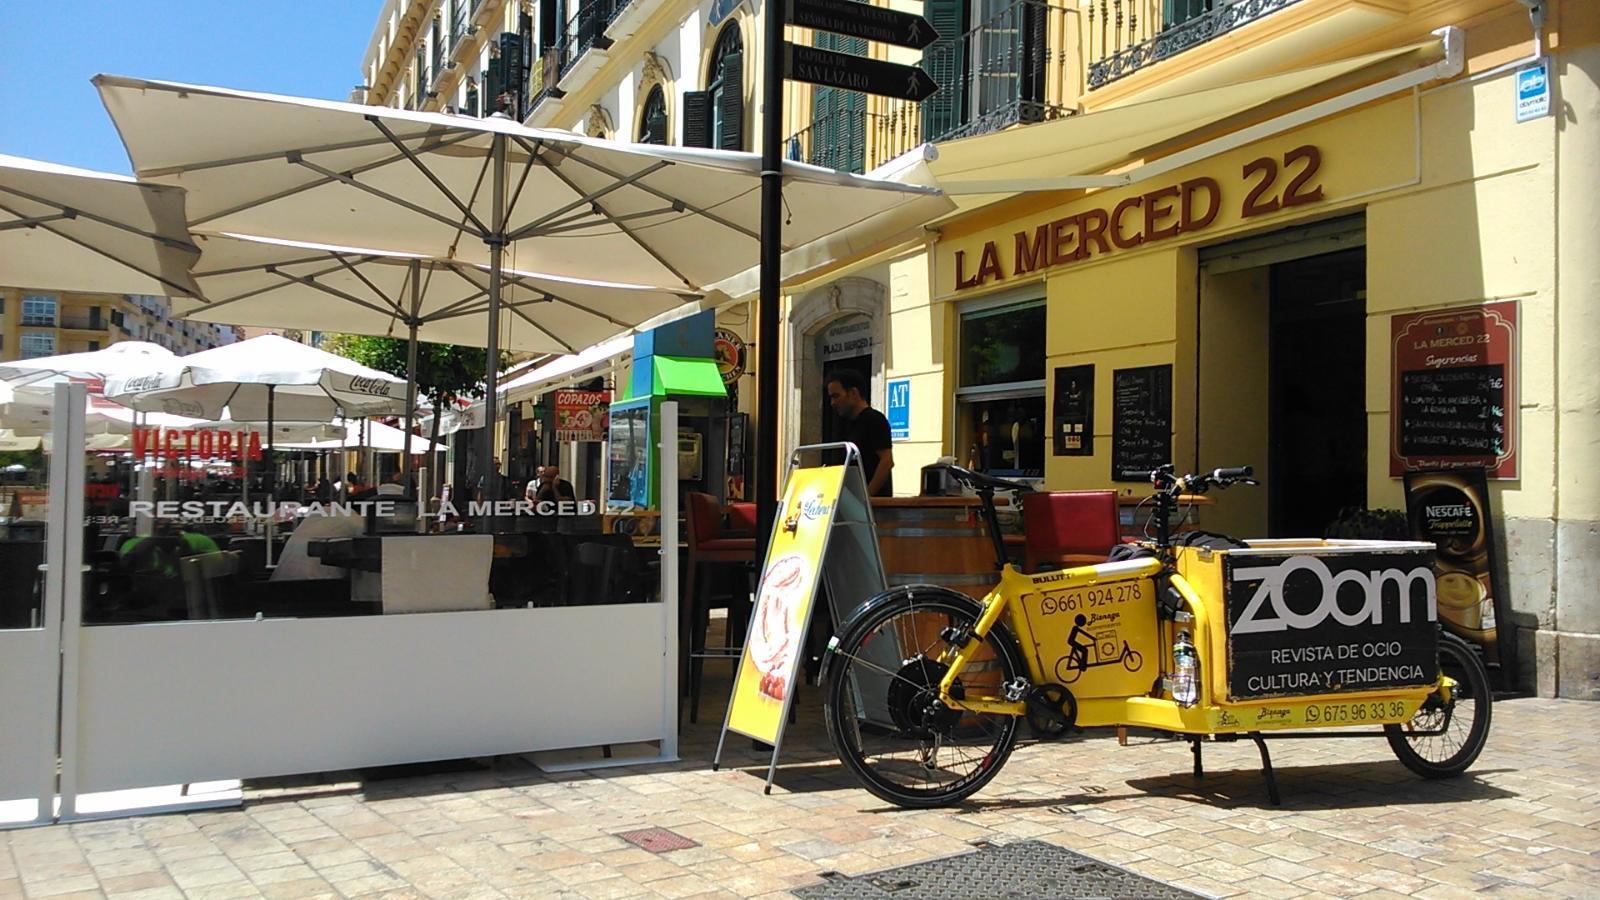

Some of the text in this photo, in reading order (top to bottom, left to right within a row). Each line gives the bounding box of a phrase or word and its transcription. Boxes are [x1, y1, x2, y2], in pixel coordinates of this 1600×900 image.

[799, 63, 820, 81] SAN
[954, 144, 1324, 291] LA MERCED 22
[1414, 333, 1490, 350] LA MERCED 22
[1425, 354, 1477, 368] Sugerencias
[558, 393, 602, 405] COPAZOS
[890, 384, 908, 408] AT
[132, 428, 263, 461] VICTORIA
[129, 501, 396, 518] RESTAURANTE
[419, 501, 459, 517] LA
[468, 501, 596, 517] MERCED
[1059, 583, 1141, 612] 661 924 278
[1272, 641, 1401, 664] REVISTA DE OCIO
[1248, 665, 1424, 691] CULTURA Y TENDENCIA
[1324, 704, 1348, 722] 675
[1351, 703, 1366, 720] 96
[1370, 702, 1386, 719] 33
[1389, 701, 1405, 717] 36
